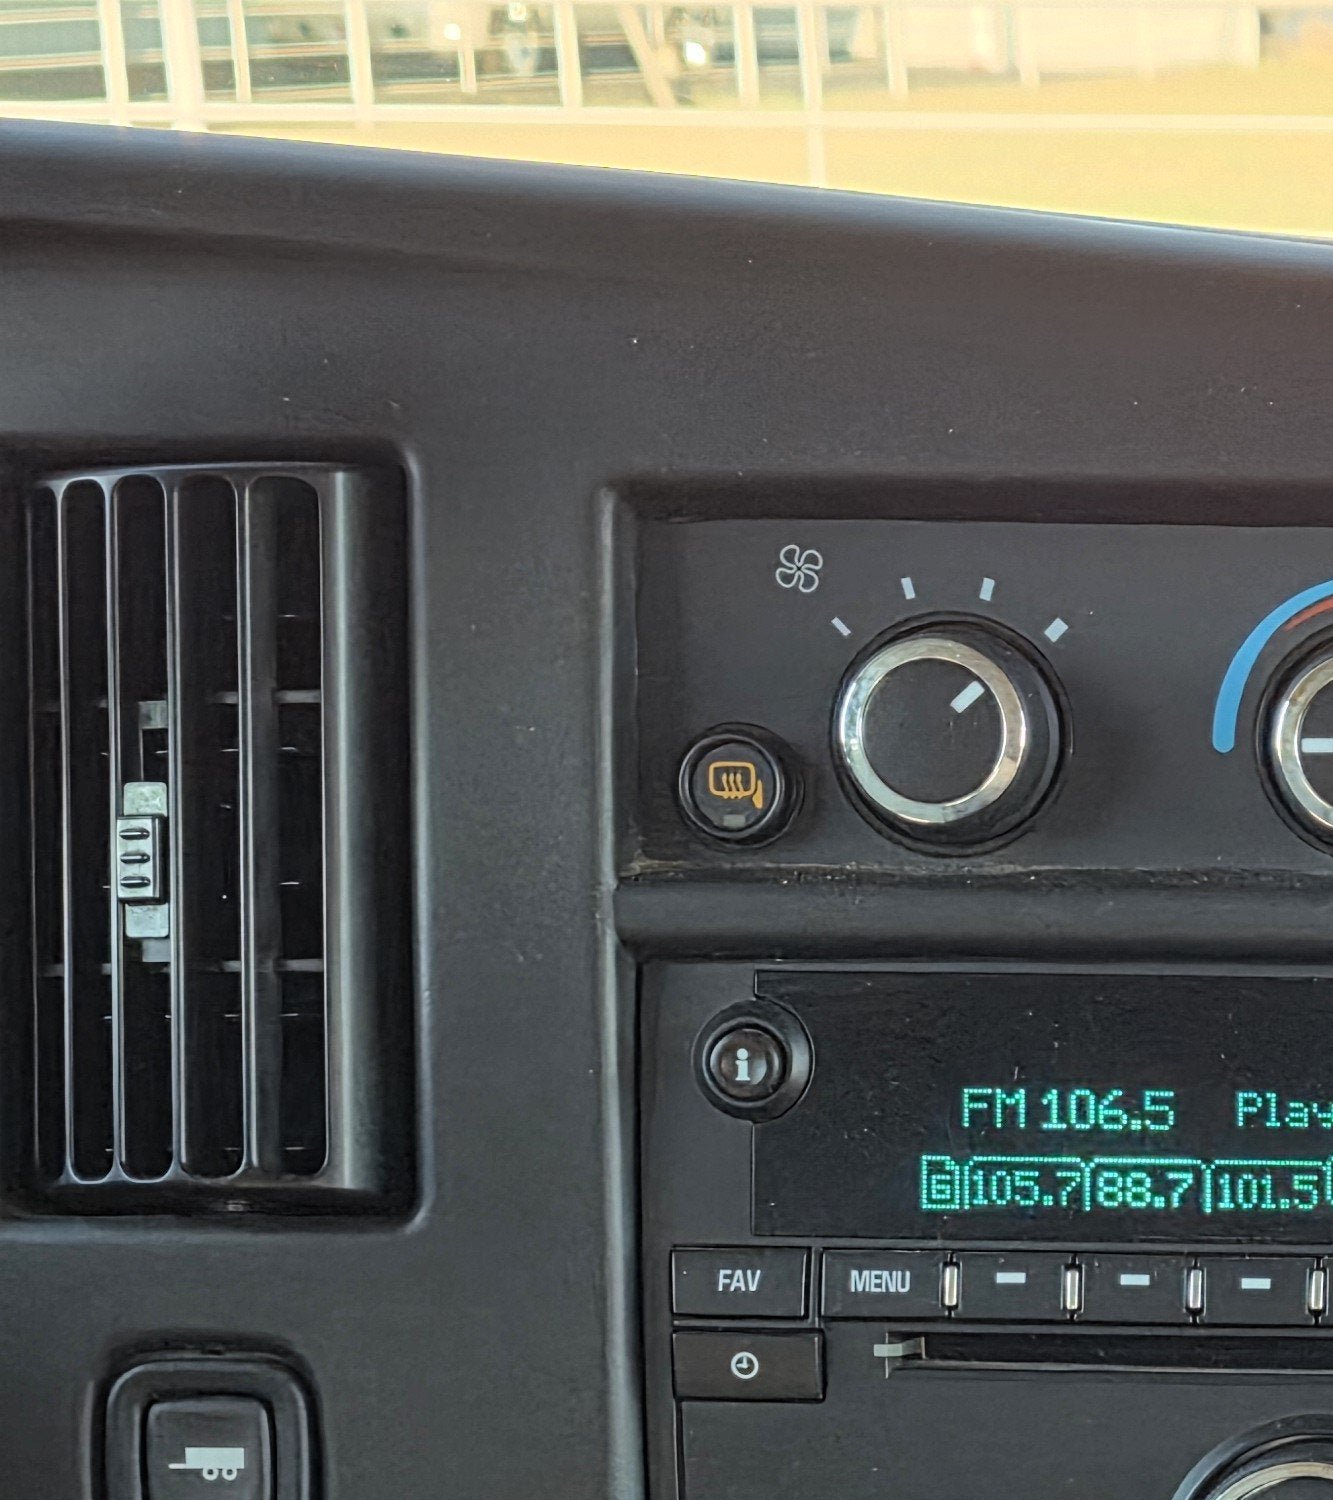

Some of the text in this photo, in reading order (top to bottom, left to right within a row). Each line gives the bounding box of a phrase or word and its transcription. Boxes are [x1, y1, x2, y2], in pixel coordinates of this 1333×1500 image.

[962, 1088, 1026, 1129] FM
[1041, 1088, 1175, 1131] 106.5
[972, 1169, 1081, 1206] 105.7
[1099, 1171, 1194, 1208] 88.7
[1217, 1172, 1319, 1210] 101.5
[718, 1269, 762, 1292] FAV
[850, 1269, 911, 1293] MENU
